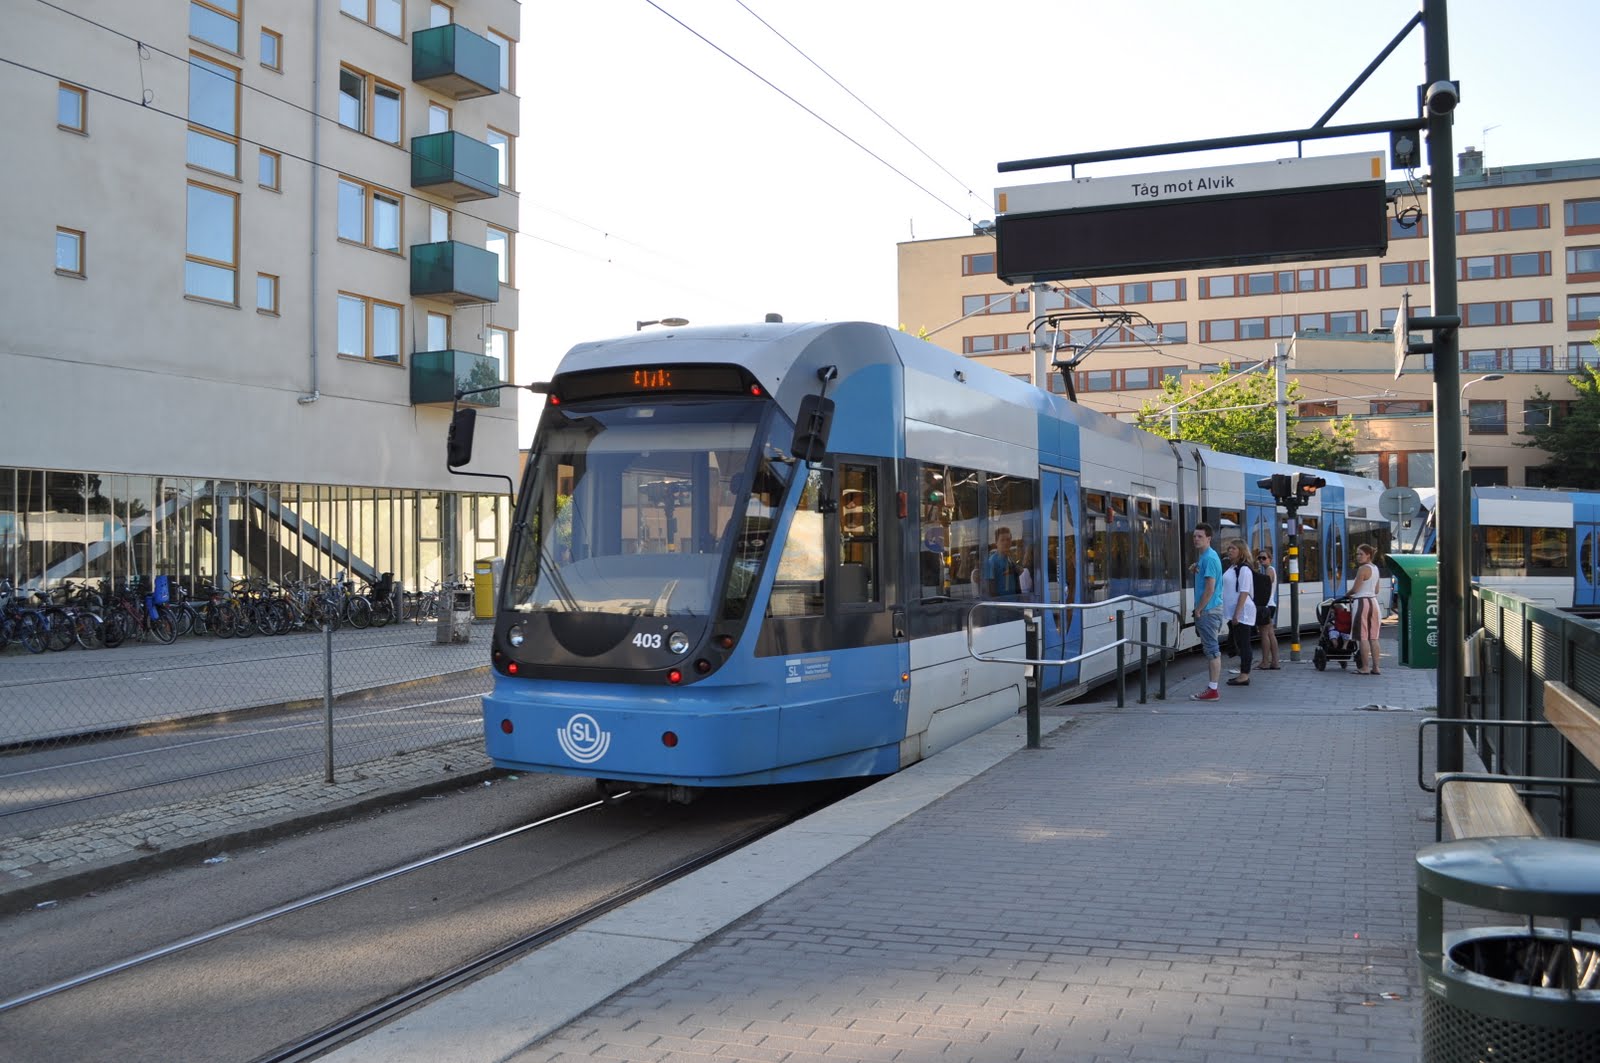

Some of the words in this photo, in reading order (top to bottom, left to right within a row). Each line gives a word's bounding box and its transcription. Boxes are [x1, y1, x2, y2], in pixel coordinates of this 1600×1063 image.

[1131, 183, 1159, 198] Tåg
[1164, 179, 1193, 194] mot
[1197, 176, 1235, 191] Alvik
[632, 632, 662, 649] 403
[788, 665, 799, 677] SL
[572, 722, 596, 742] SL
